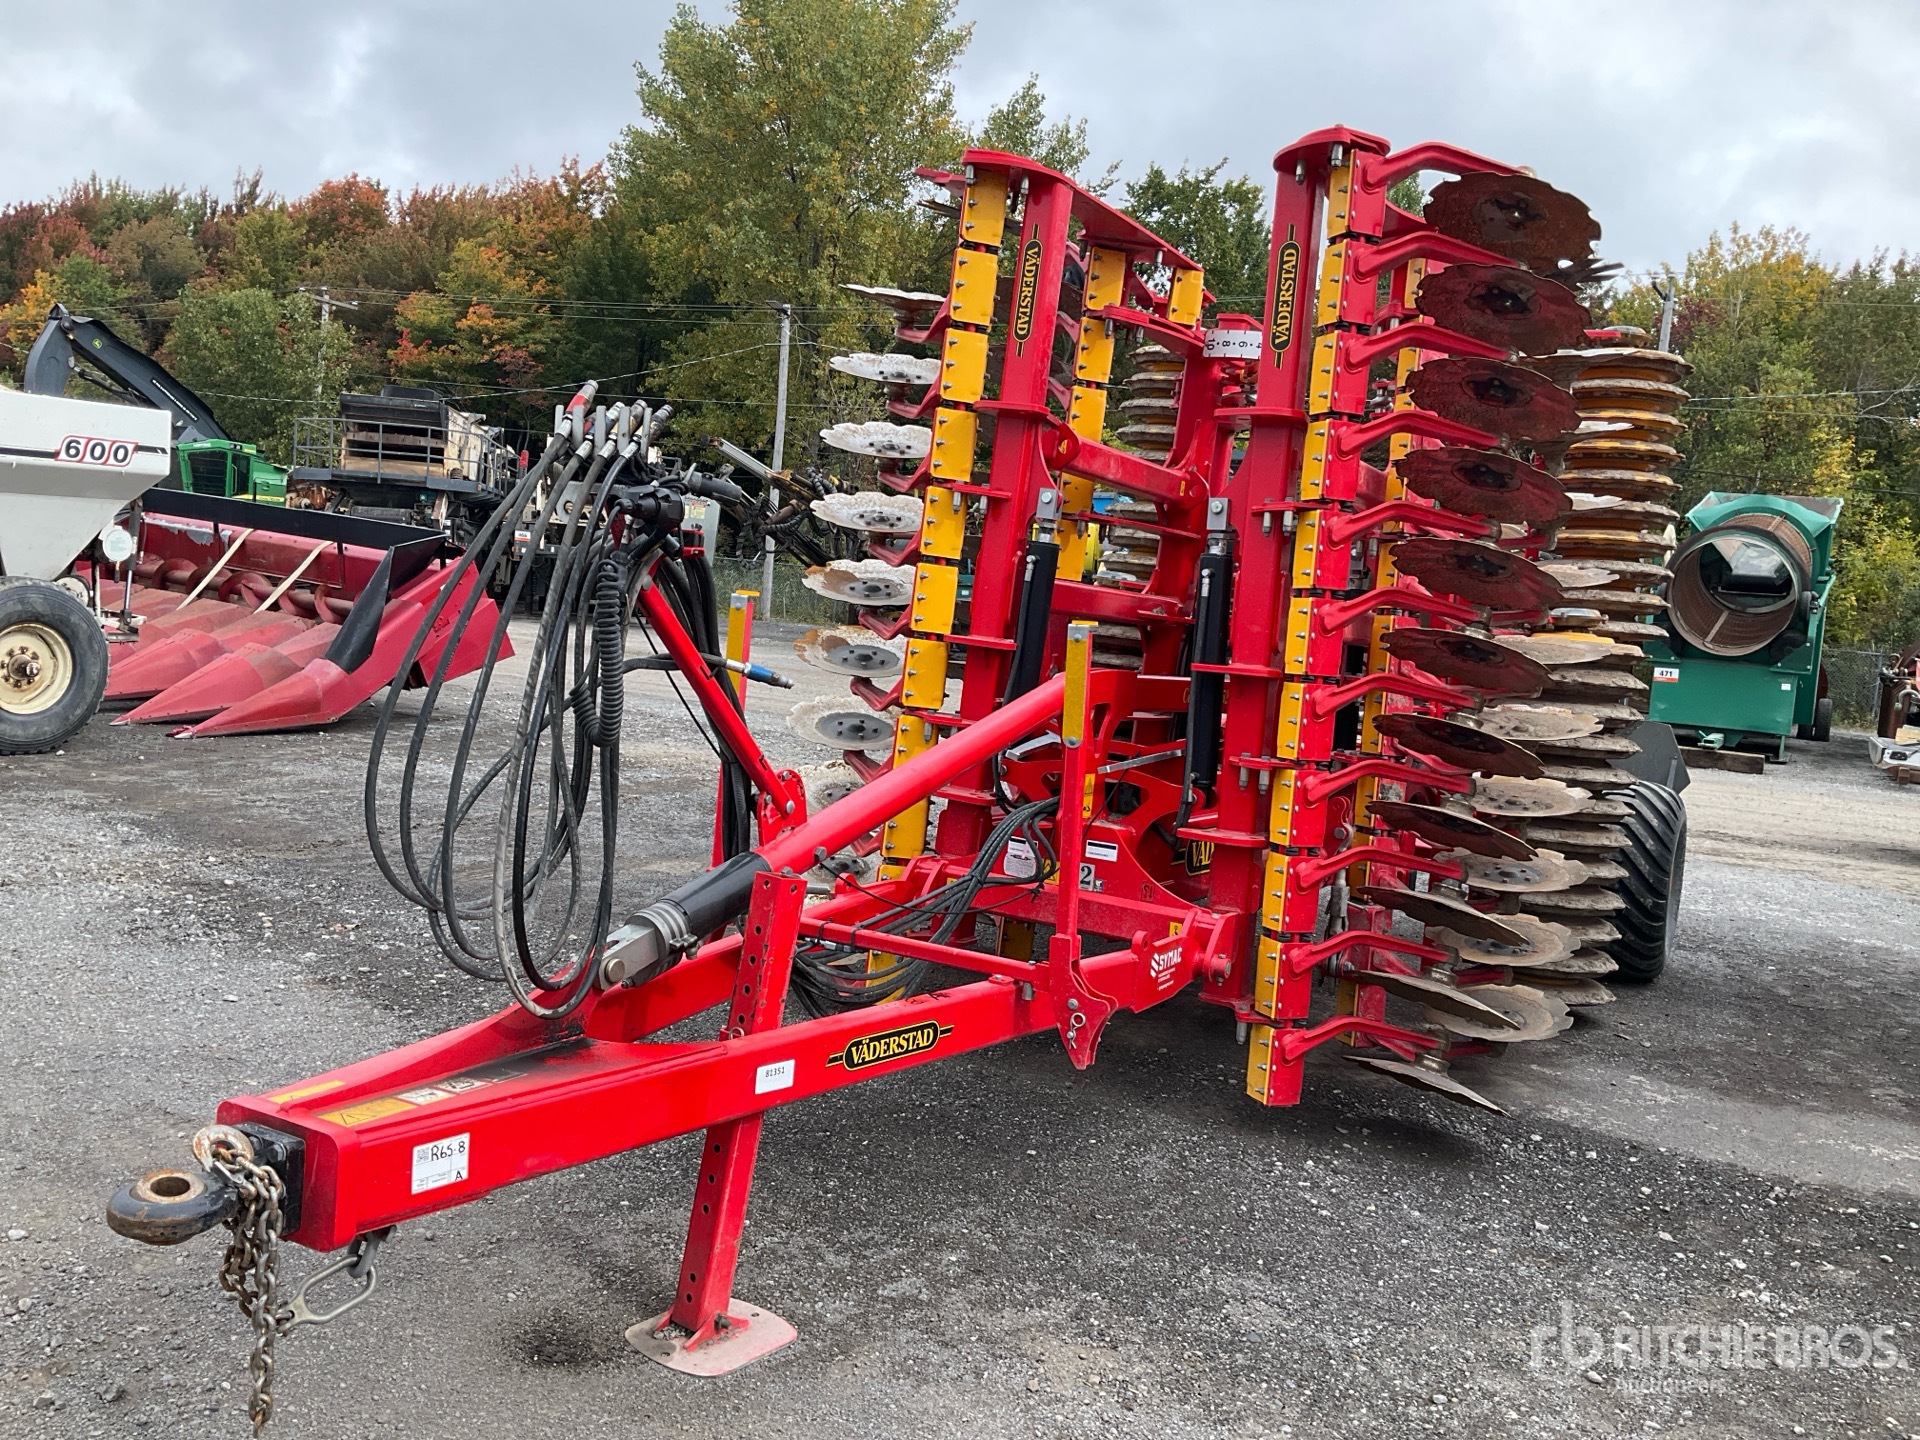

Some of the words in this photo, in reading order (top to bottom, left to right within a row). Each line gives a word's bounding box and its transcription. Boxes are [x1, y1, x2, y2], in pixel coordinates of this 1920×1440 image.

[1016, 246, 1040, 335] VÄDERSTAD
[1273, 248, 1297, 344] VÄDERSTAD
[65, 439, 129, 463] 600
[851, 1028, 934, 1064] VÄDERSTAD
